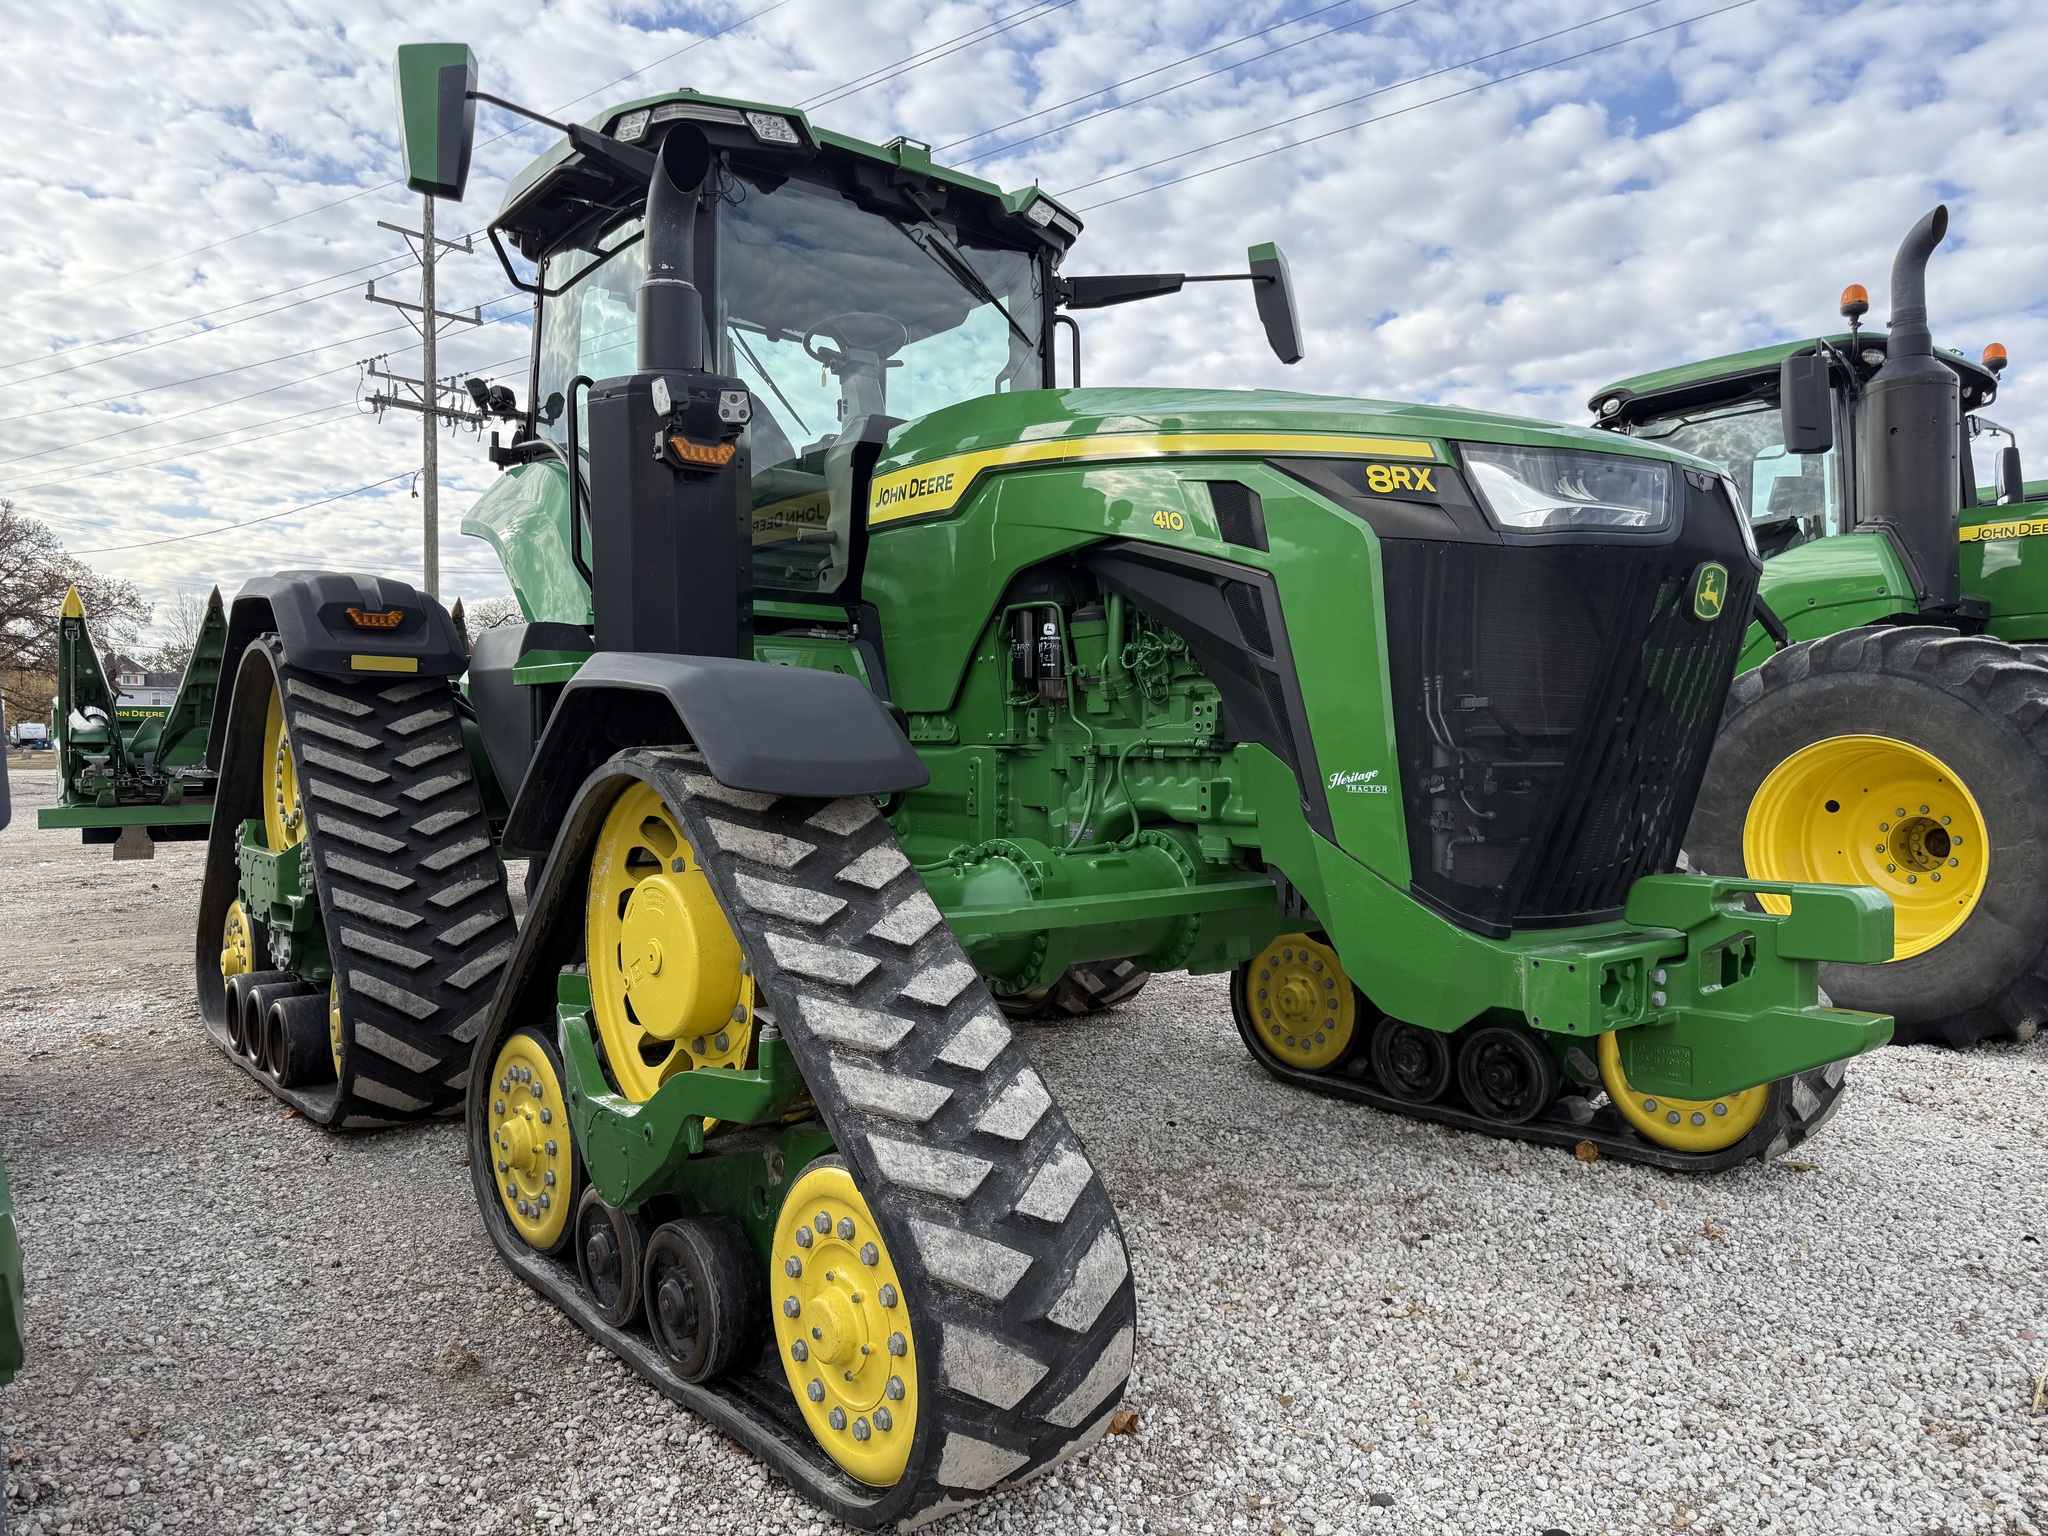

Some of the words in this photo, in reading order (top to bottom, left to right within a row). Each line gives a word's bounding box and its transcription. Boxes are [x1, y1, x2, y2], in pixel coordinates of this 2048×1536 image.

[1366, 464, 1437, 493] 8RX
[875, 484, 907, 508] JOHN
[909, 472, 955, 499] DEERE
[1152, 510, 1184, 531] 410
[1972, 526, 2016, 540] JOHN
[2019, 523, 2048, 535] DEE
[131, 709, 165, 718] DEERE
[1328, 769, 1379, 789] Heritage
[1346, 785, 1388, 793] TRACTOR
